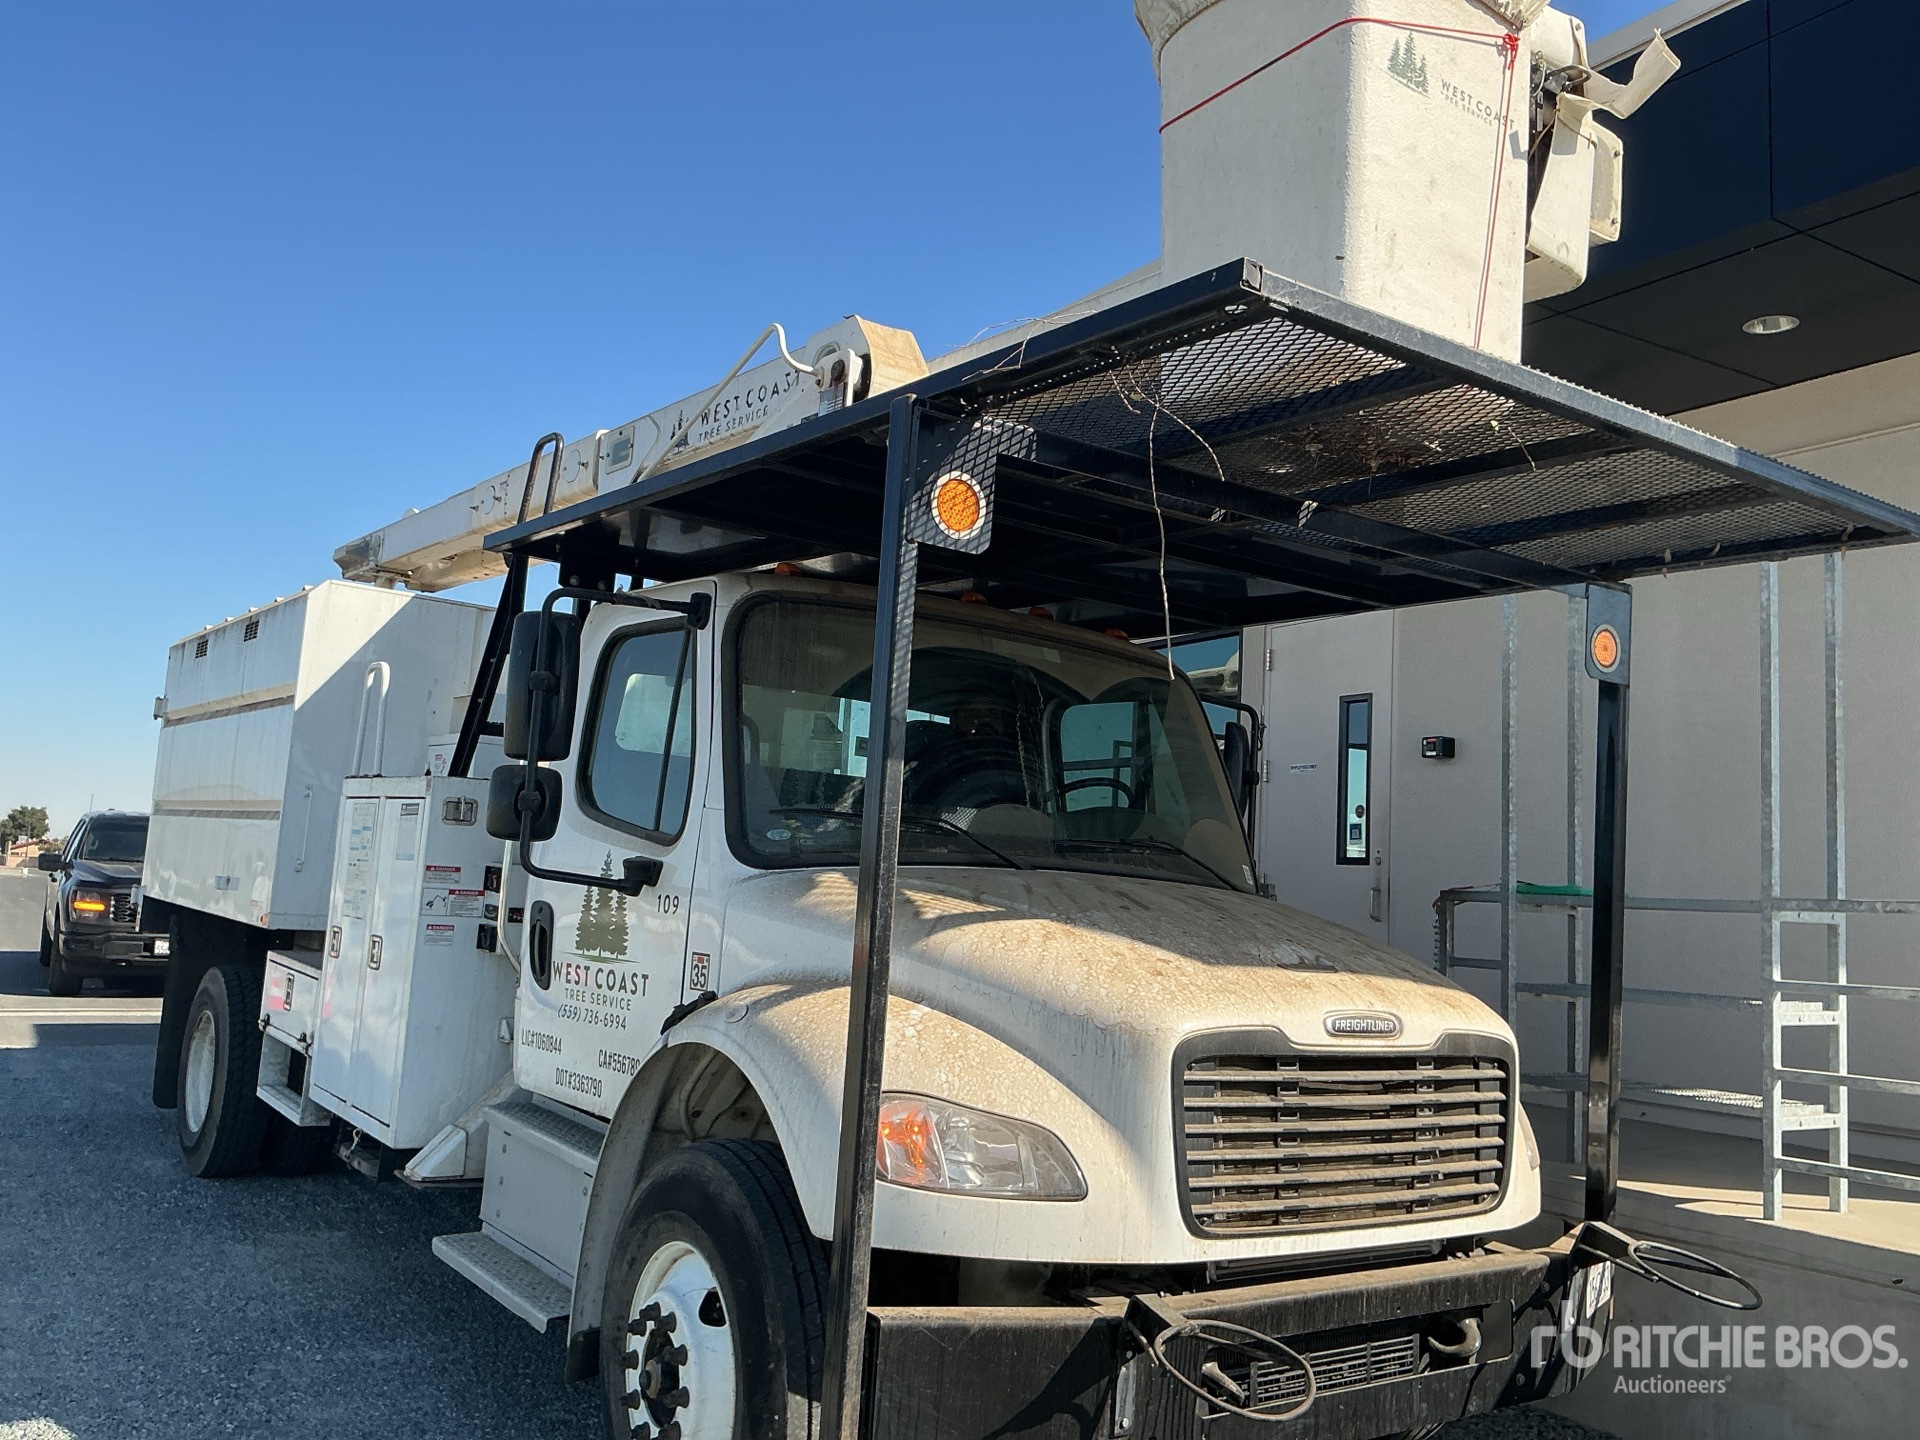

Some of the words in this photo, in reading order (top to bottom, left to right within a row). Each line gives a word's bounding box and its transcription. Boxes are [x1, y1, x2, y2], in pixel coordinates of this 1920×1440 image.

[1441, 78, 1473, 105] WEST
[1476, 100, 1515, 130] COAST
[701, 395, 741, 427] WEST
[746, 369, 801, 409] COAST
[698, 422, 722, 444] TREE
[725, 404, 769, 433] SERVICE
[657, 893, 680, 915] 109
[552, 960, 591, 987] WEST
[594, 967, 650, 997] COAST
[691, 963, 708, 989] 35
[564, 987, 587, 1003] TREE
[590, 992, 632, 1011] SERVICE
[557, 1003, 582, 1023] (559)
[583, 1008, 628, 1031] 736-6994
[1334, 1018, 1395, 1031] FREIGHTLINER
[555, 1067, 603, 1099] DOT#3363790
